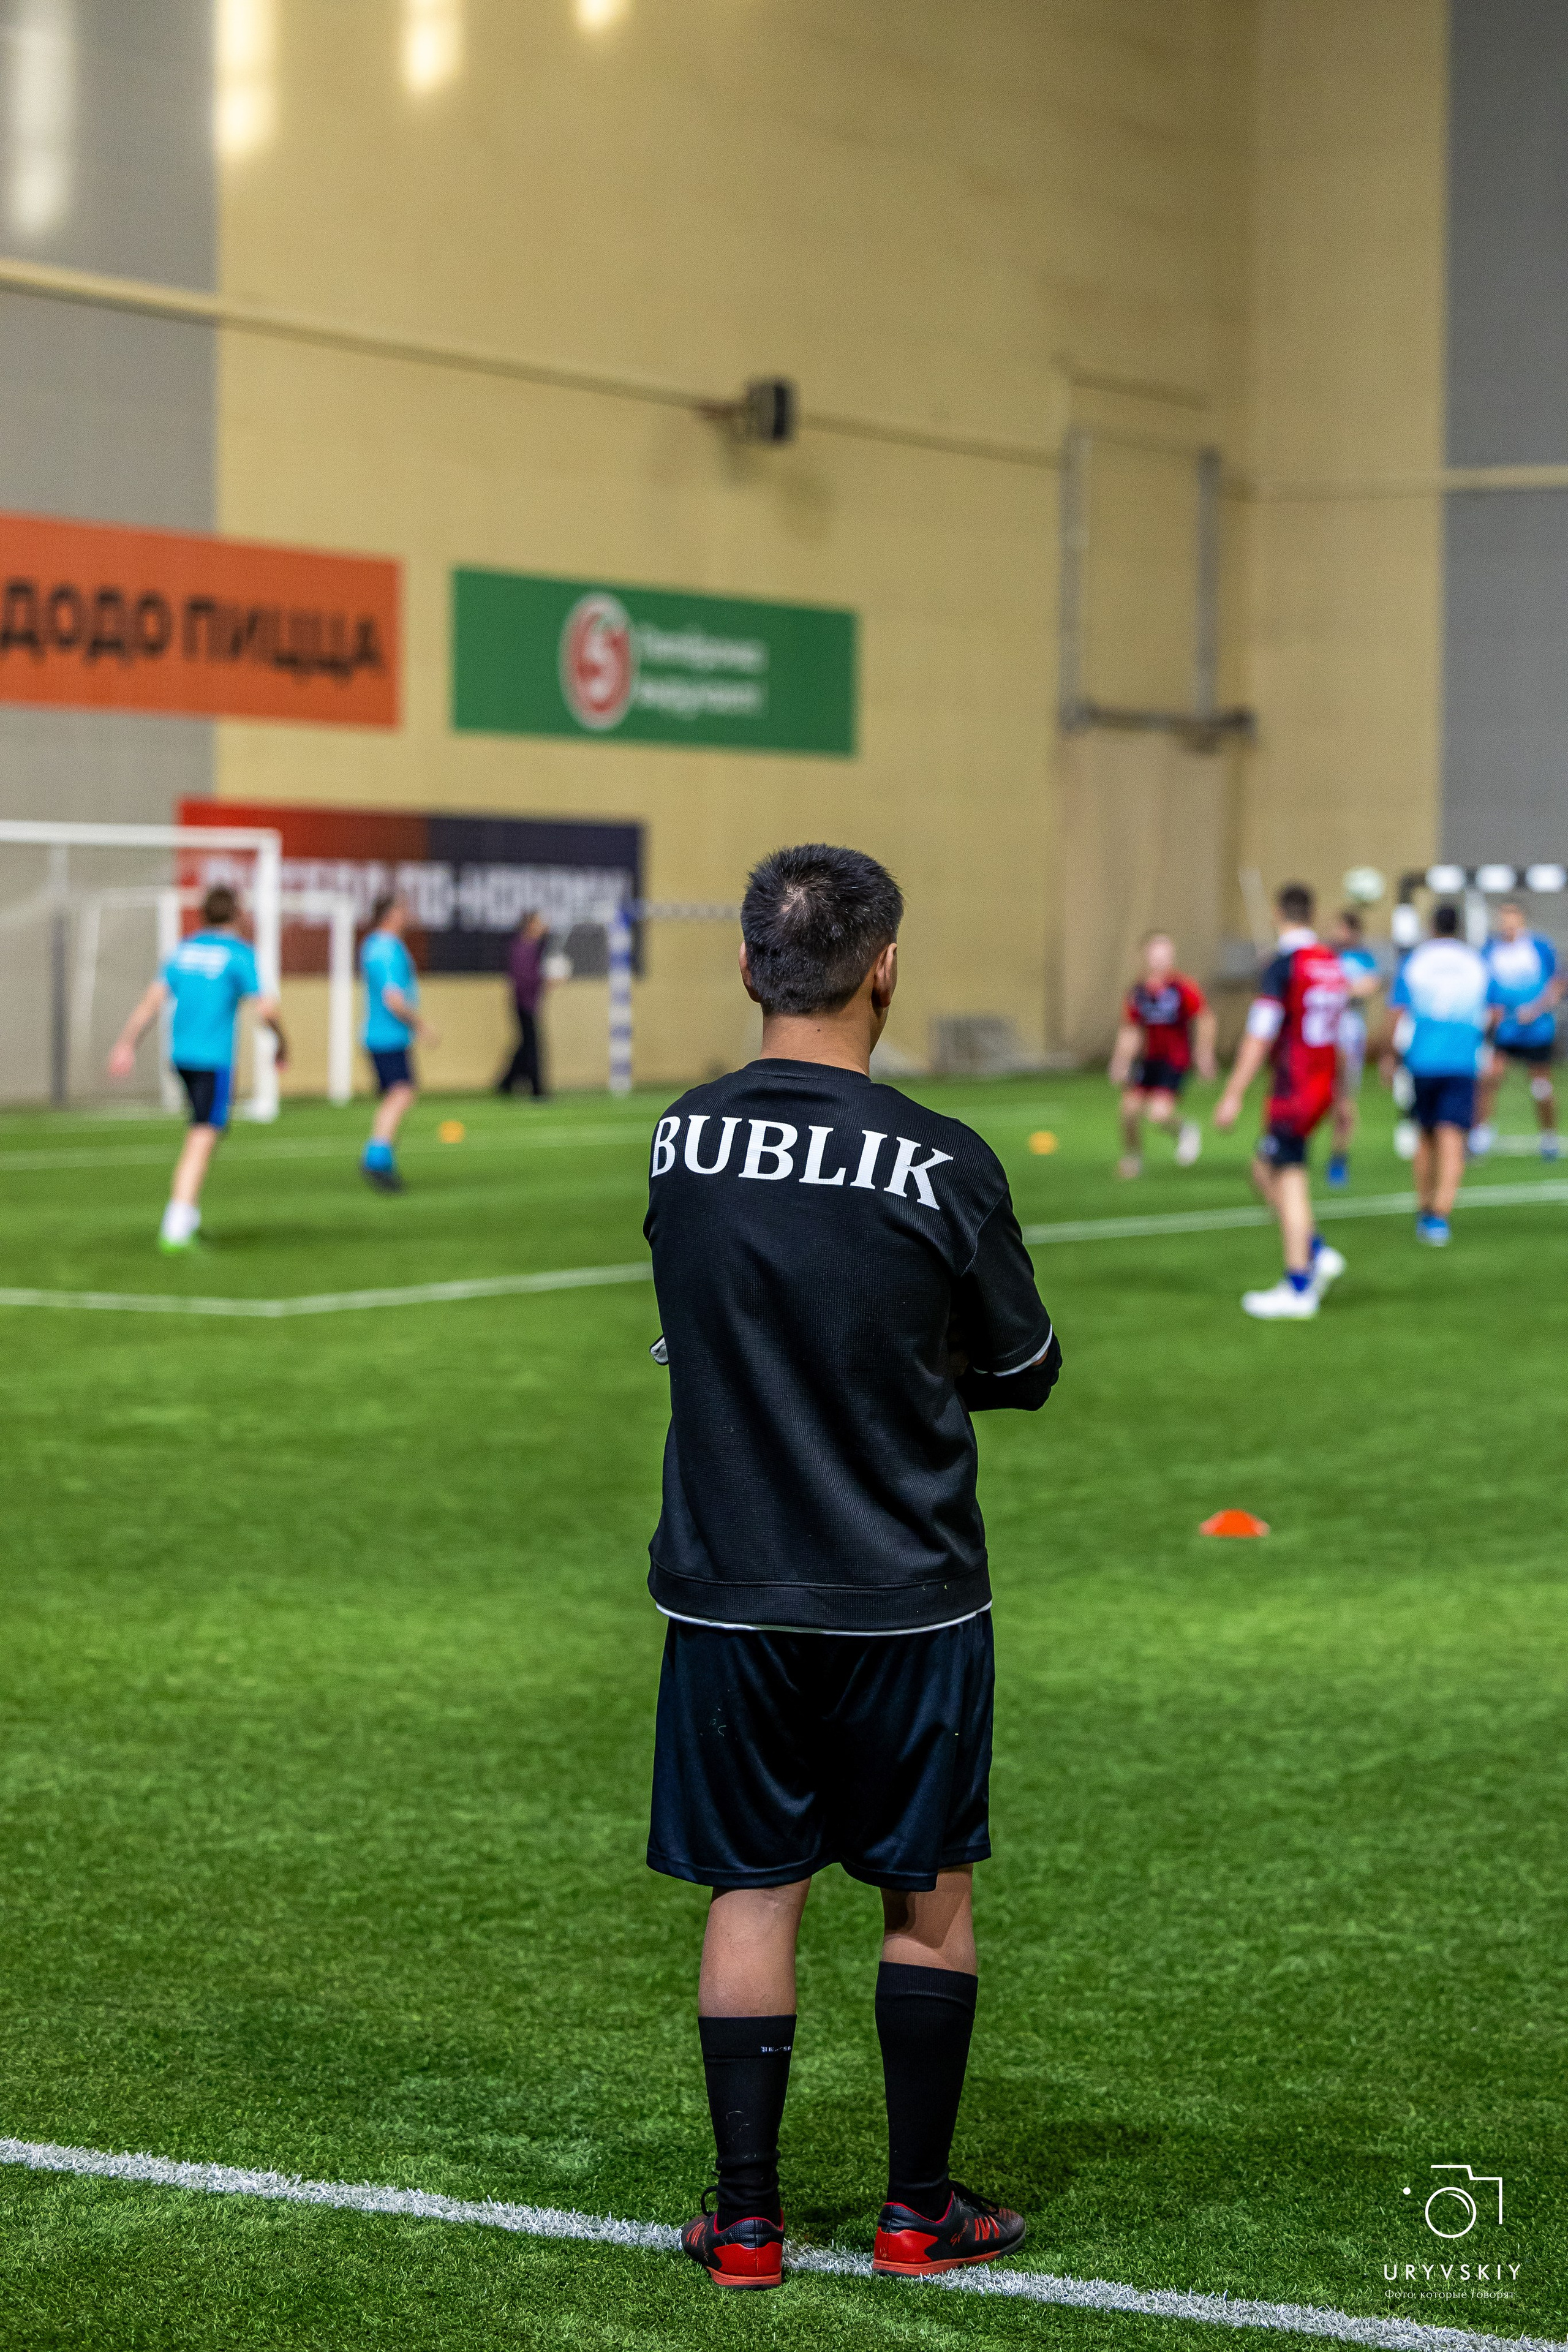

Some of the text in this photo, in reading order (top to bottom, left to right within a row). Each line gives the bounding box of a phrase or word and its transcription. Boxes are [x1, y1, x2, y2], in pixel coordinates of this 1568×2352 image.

[0, 576, 385, 686] ДОДО ПИЦЦА
[651, 1114, 954, 1210] BUBLIK
